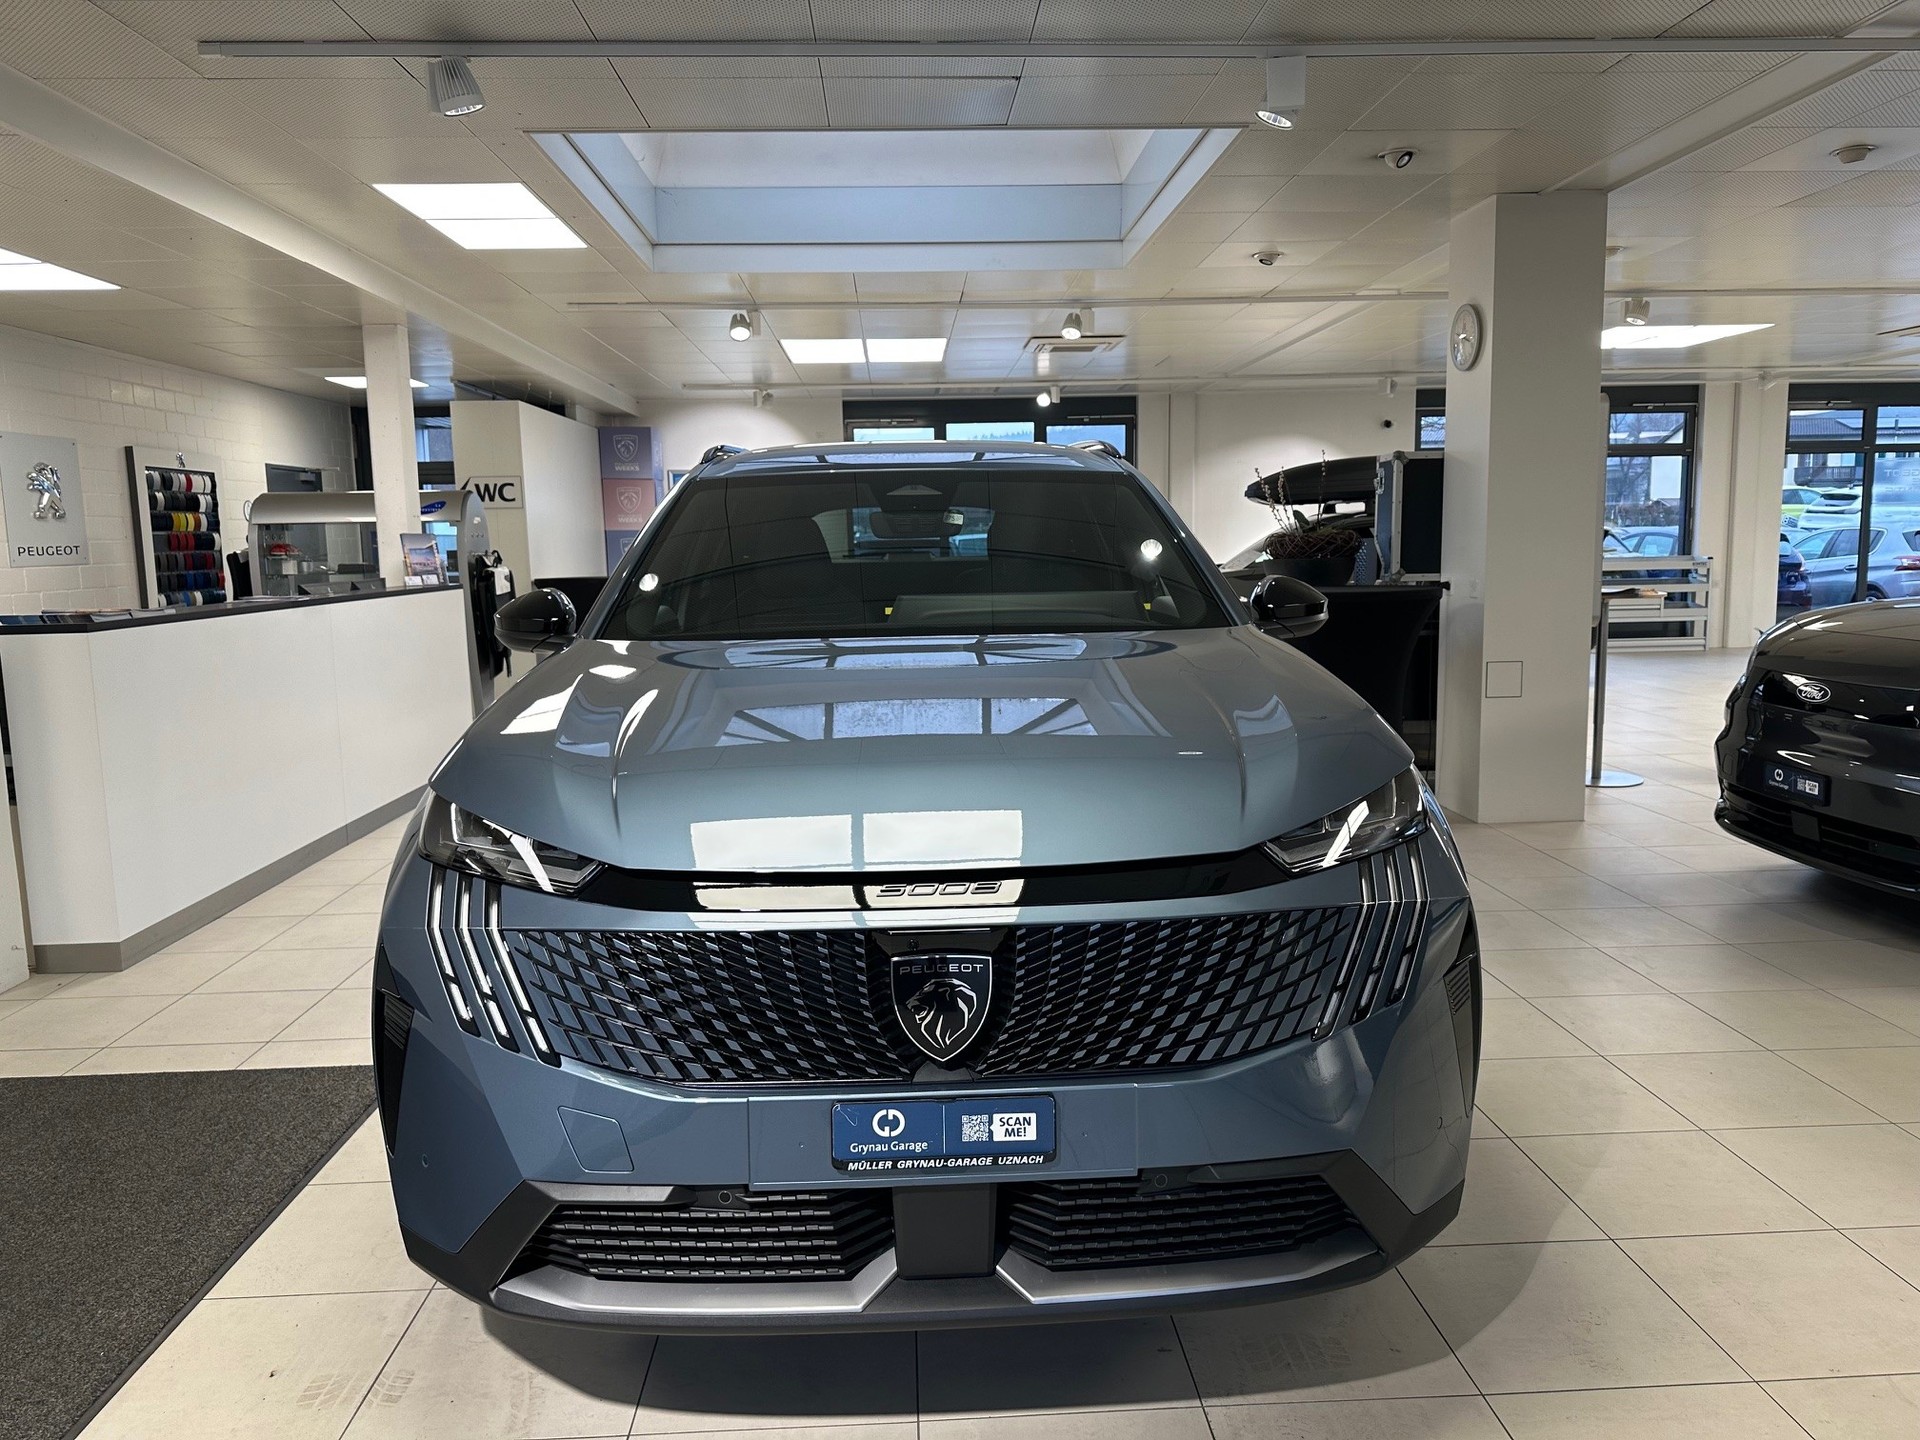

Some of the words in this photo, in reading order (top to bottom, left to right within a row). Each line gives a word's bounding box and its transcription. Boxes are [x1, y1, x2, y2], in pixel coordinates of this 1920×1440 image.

[474, 482, 516, 503] WC
[17, 545, 81, 557] PEUGEOT
[876, 881, 1002, 898] 5008
[899, 963, 984, 975] PEUGEOT
[999, 1116, 1031, 1127] SCAN
[1004, 1127, 1027, 1138] ME!
[850, 1142, 888, 1155] Grynau
[891, 1141, 928, 1153] Garage
[847, 1159, 893, 1171] MÜLLER
[897, 1156, 993, 1169] GRYNAU-GARAGE
[998, 1155, 1044, 1165] UZNACH
